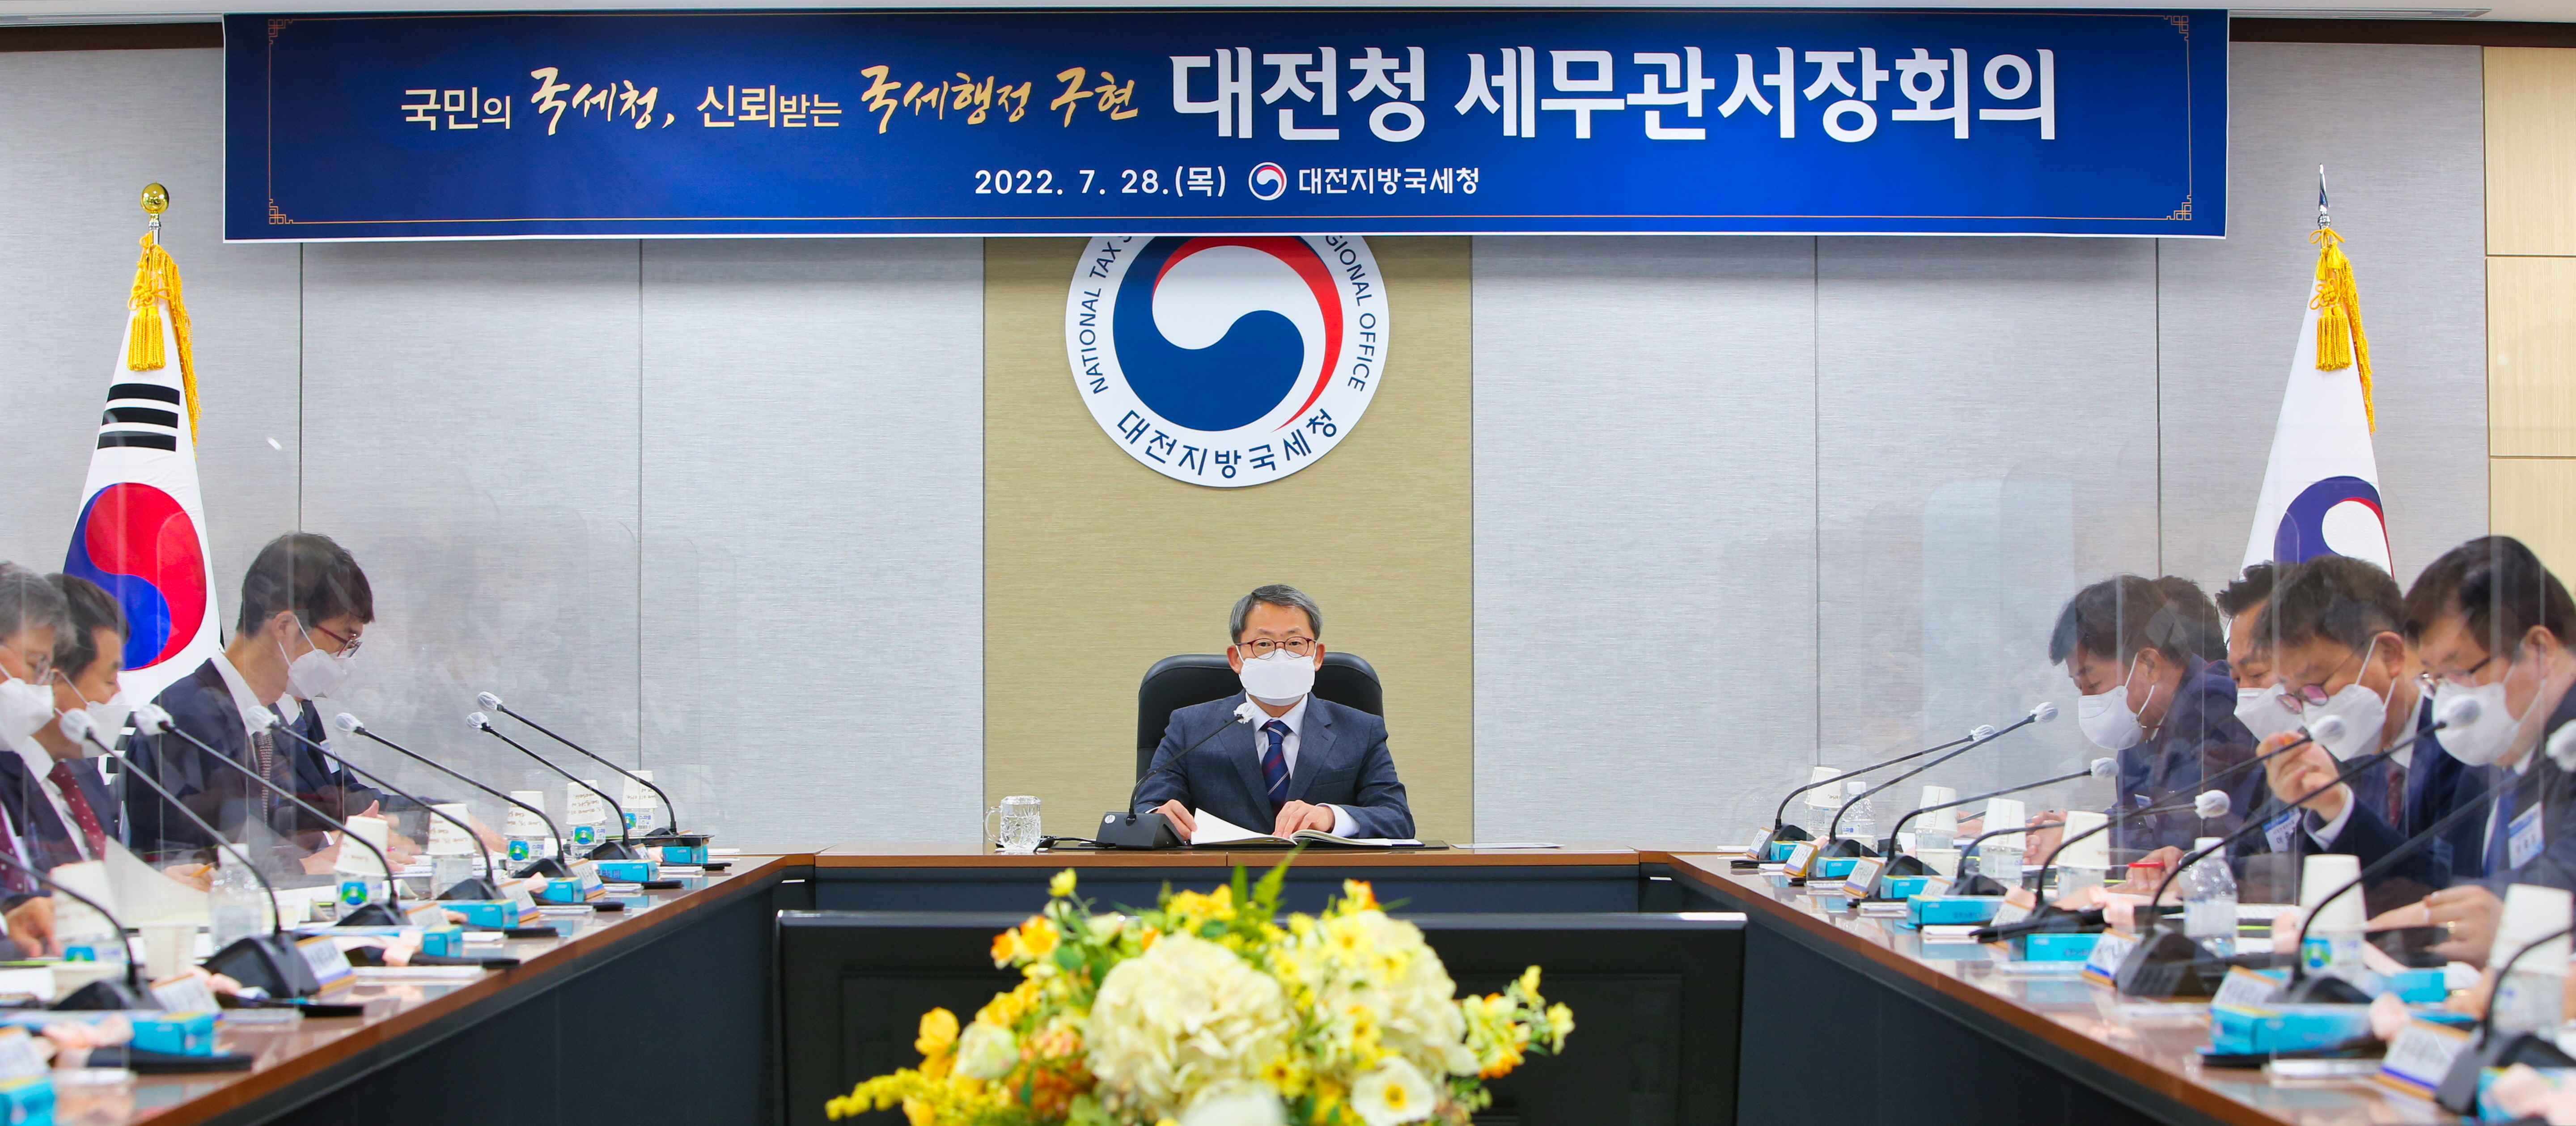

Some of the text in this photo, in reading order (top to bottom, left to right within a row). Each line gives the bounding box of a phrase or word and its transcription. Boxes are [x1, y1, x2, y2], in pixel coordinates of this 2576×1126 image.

[401, 65, 1138, 135] 국민의 국세청, 신뢰받는 국세행정 구현
[1169, 46, 2055, 142] 대전청 세무관서장회의
[975, 166, 1225, 197] 2022. 7. 28.(목)
[1299, 168, 1479, 195] 대전지방국세청
[1079, 241, 1122, 394] NATIONAL TAX
[1347, 313, 1376, 392] OFFICE
[1117, 408, 1337, 478] 대전지방국세청
